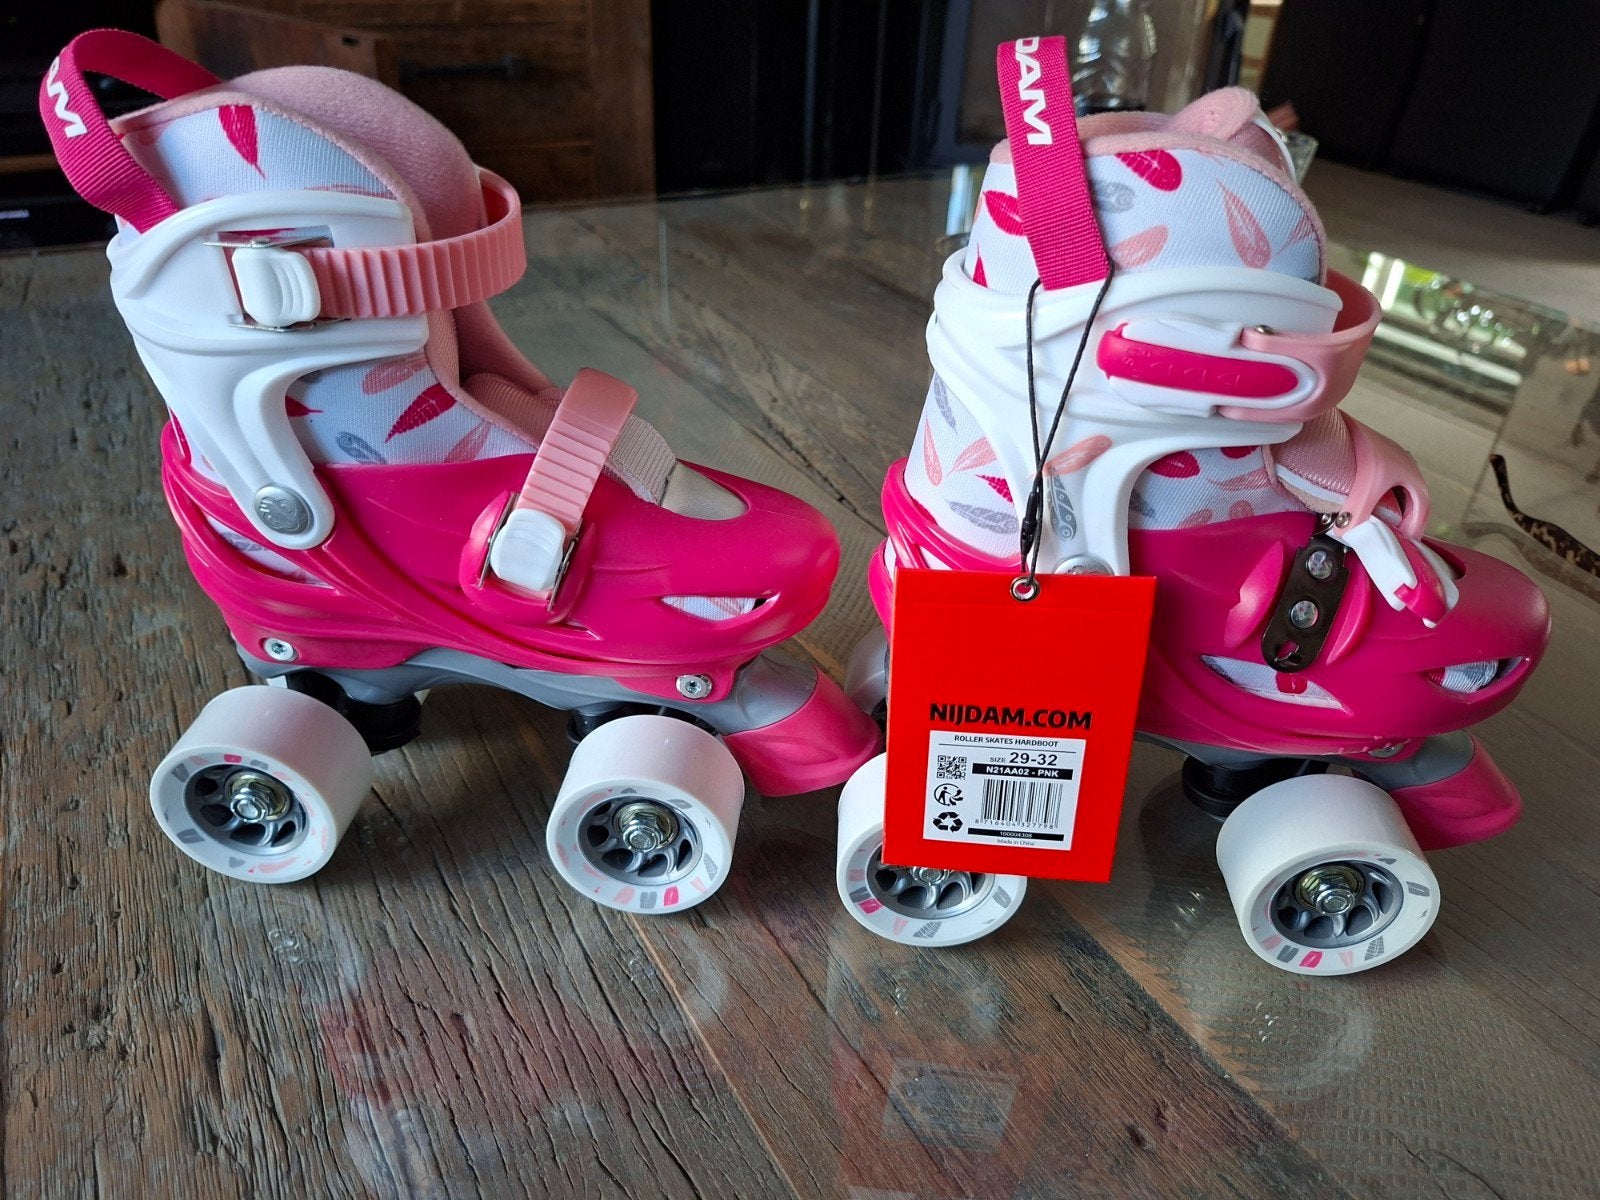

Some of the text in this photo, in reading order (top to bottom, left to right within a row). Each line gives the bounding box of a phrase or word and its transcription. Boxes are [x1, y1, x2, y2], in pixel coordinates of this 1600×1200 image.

[929, 703, 1093, 730] NIJDAM.COM
[954, 735, 1058, 748] ROLLER SKATES HARDBOOT
[1009, 752, 1058, 766] 29-32
[986, 766, 1030, 776] N21AA02
[1038, 769, 1059, 778] PNK
